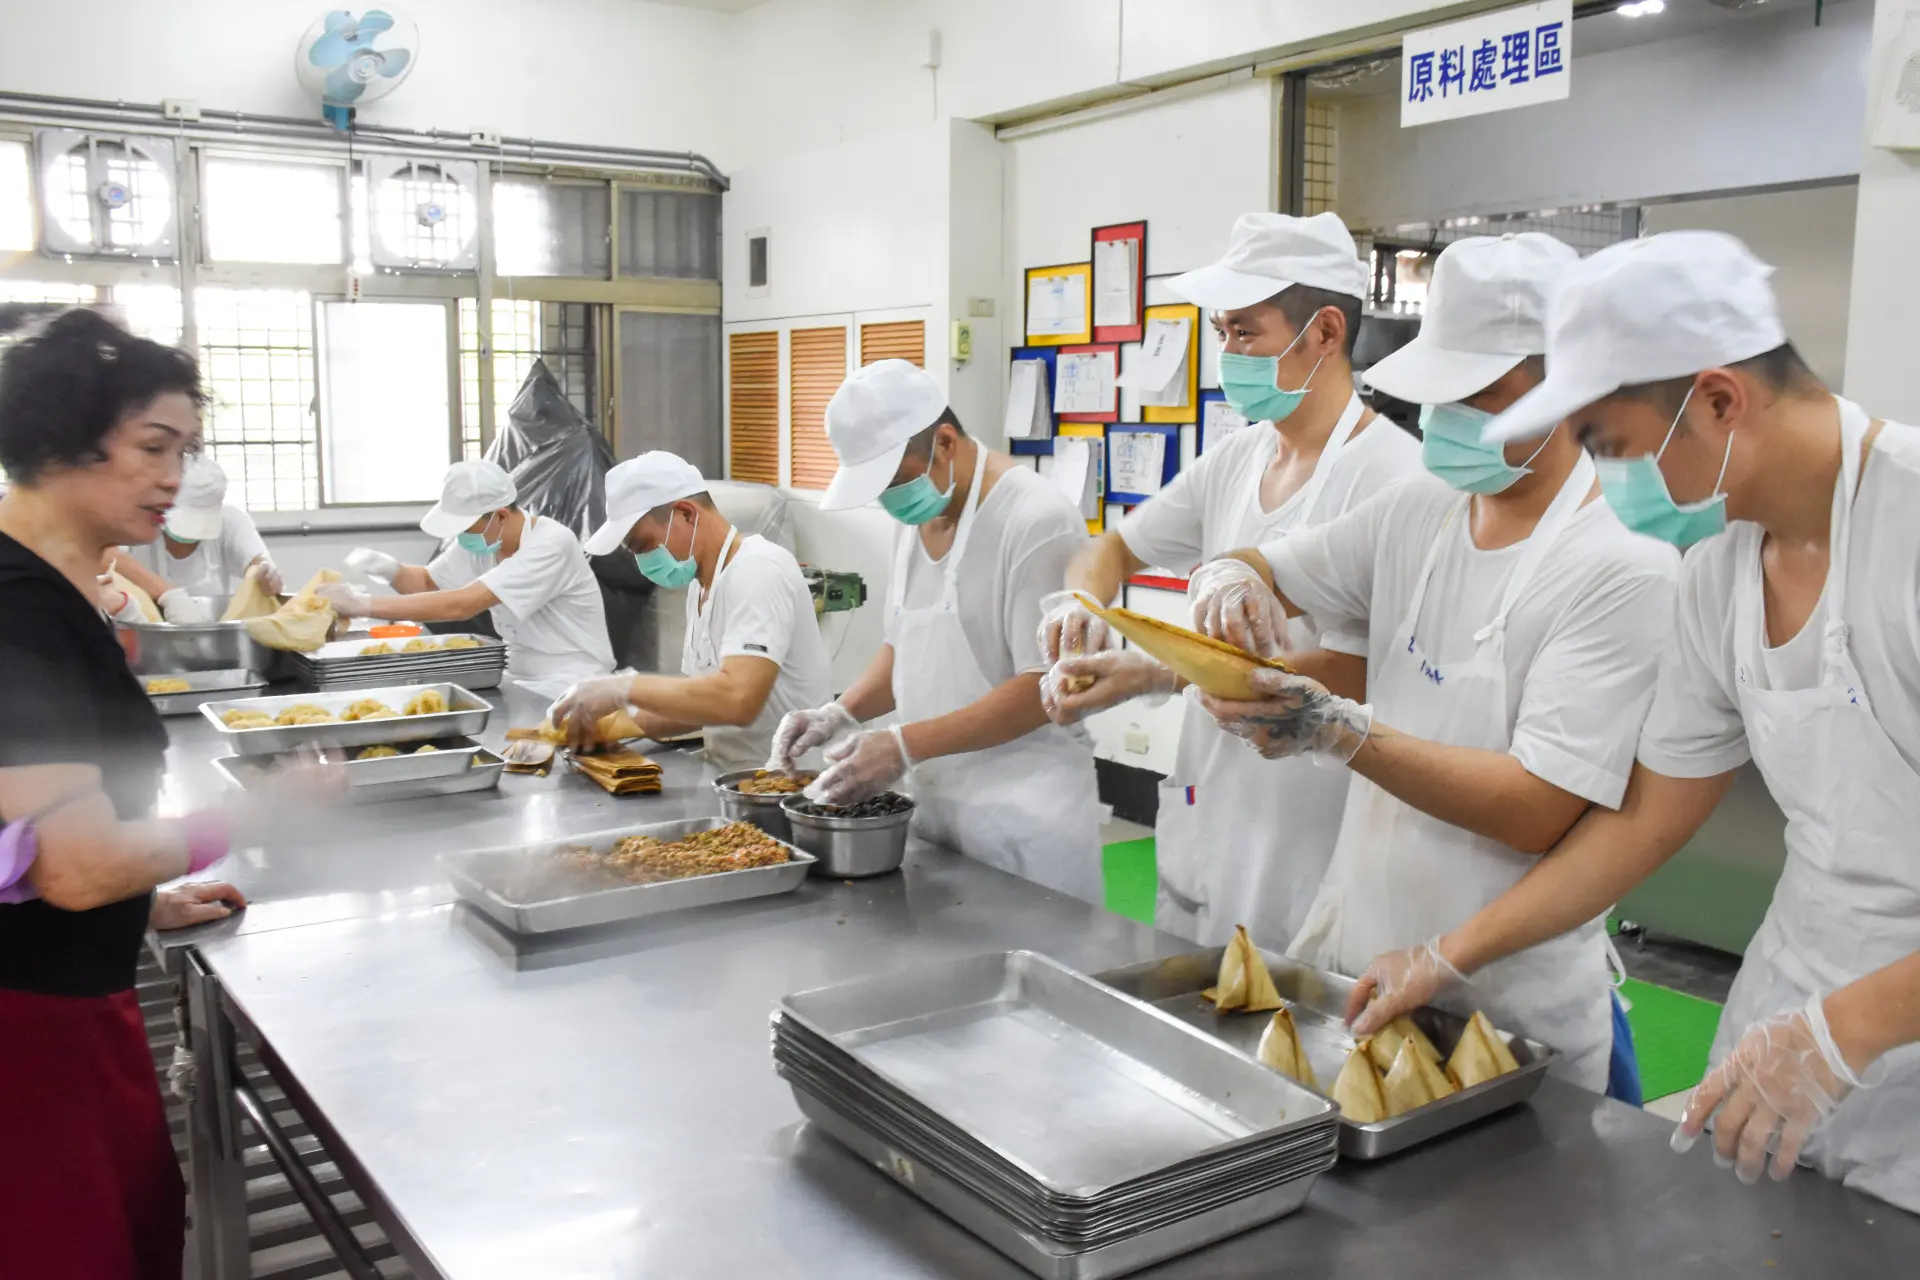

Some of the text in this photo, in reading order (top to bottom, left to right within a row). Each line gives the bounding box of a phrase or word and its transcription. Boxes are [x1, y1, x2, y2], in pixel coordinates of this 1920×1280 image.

[1408, 21, 1563, 102] 原料處理區
